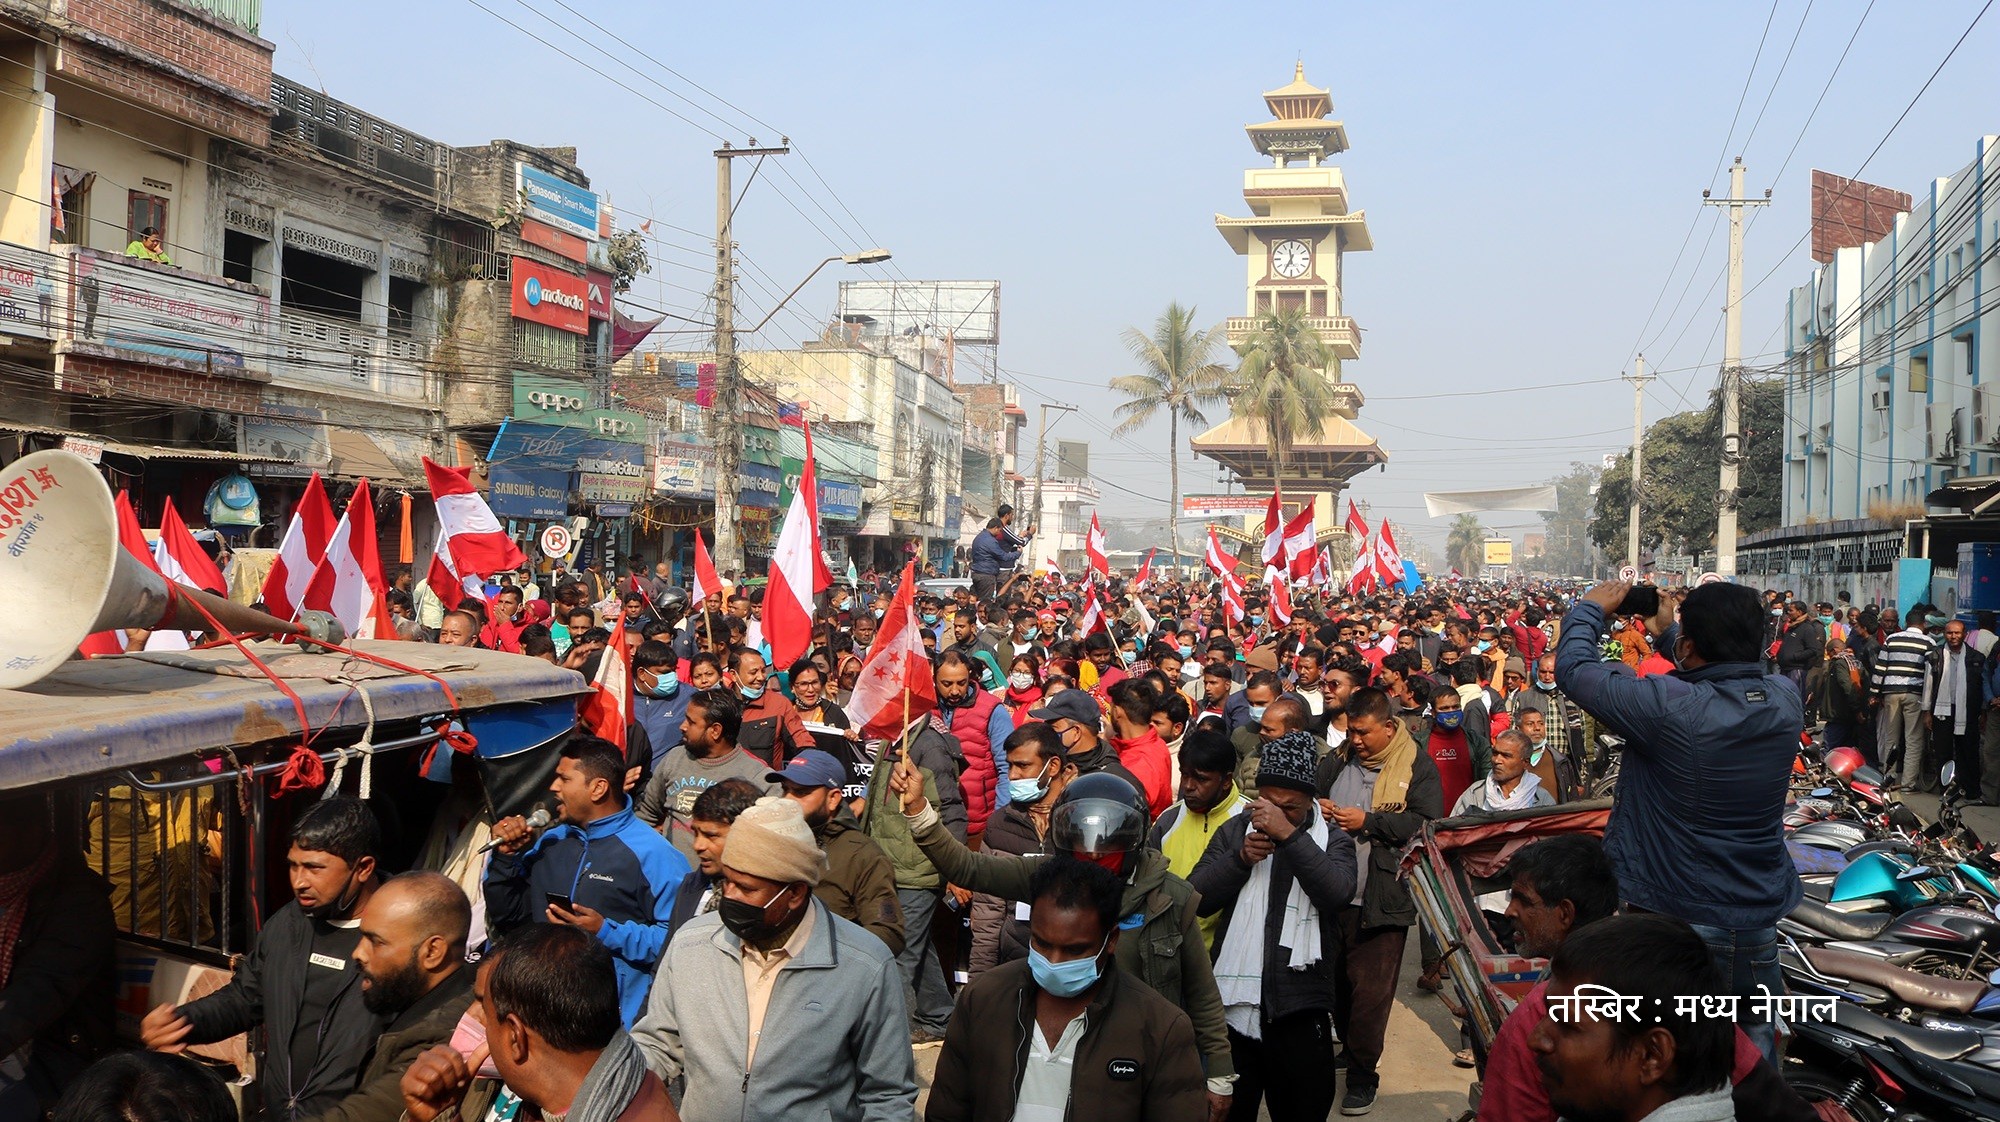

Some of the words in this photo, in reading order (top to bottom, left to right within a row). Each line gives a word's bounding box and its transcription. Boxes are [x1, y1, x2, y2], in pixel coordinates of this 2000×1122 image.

[526, 179, 562, 204] Panasonic
[564, 196, 579, 212] Smart
[578, 202, 595, 218] Phones
[541, 288, 584, 312] motorola
[741, 434, 773, 452] ppo
[616, 460, 645, 478] Galaxy
[495, 482, 535, 497] SAMSUNG
[538, 486, 566, 502] Galaxy
